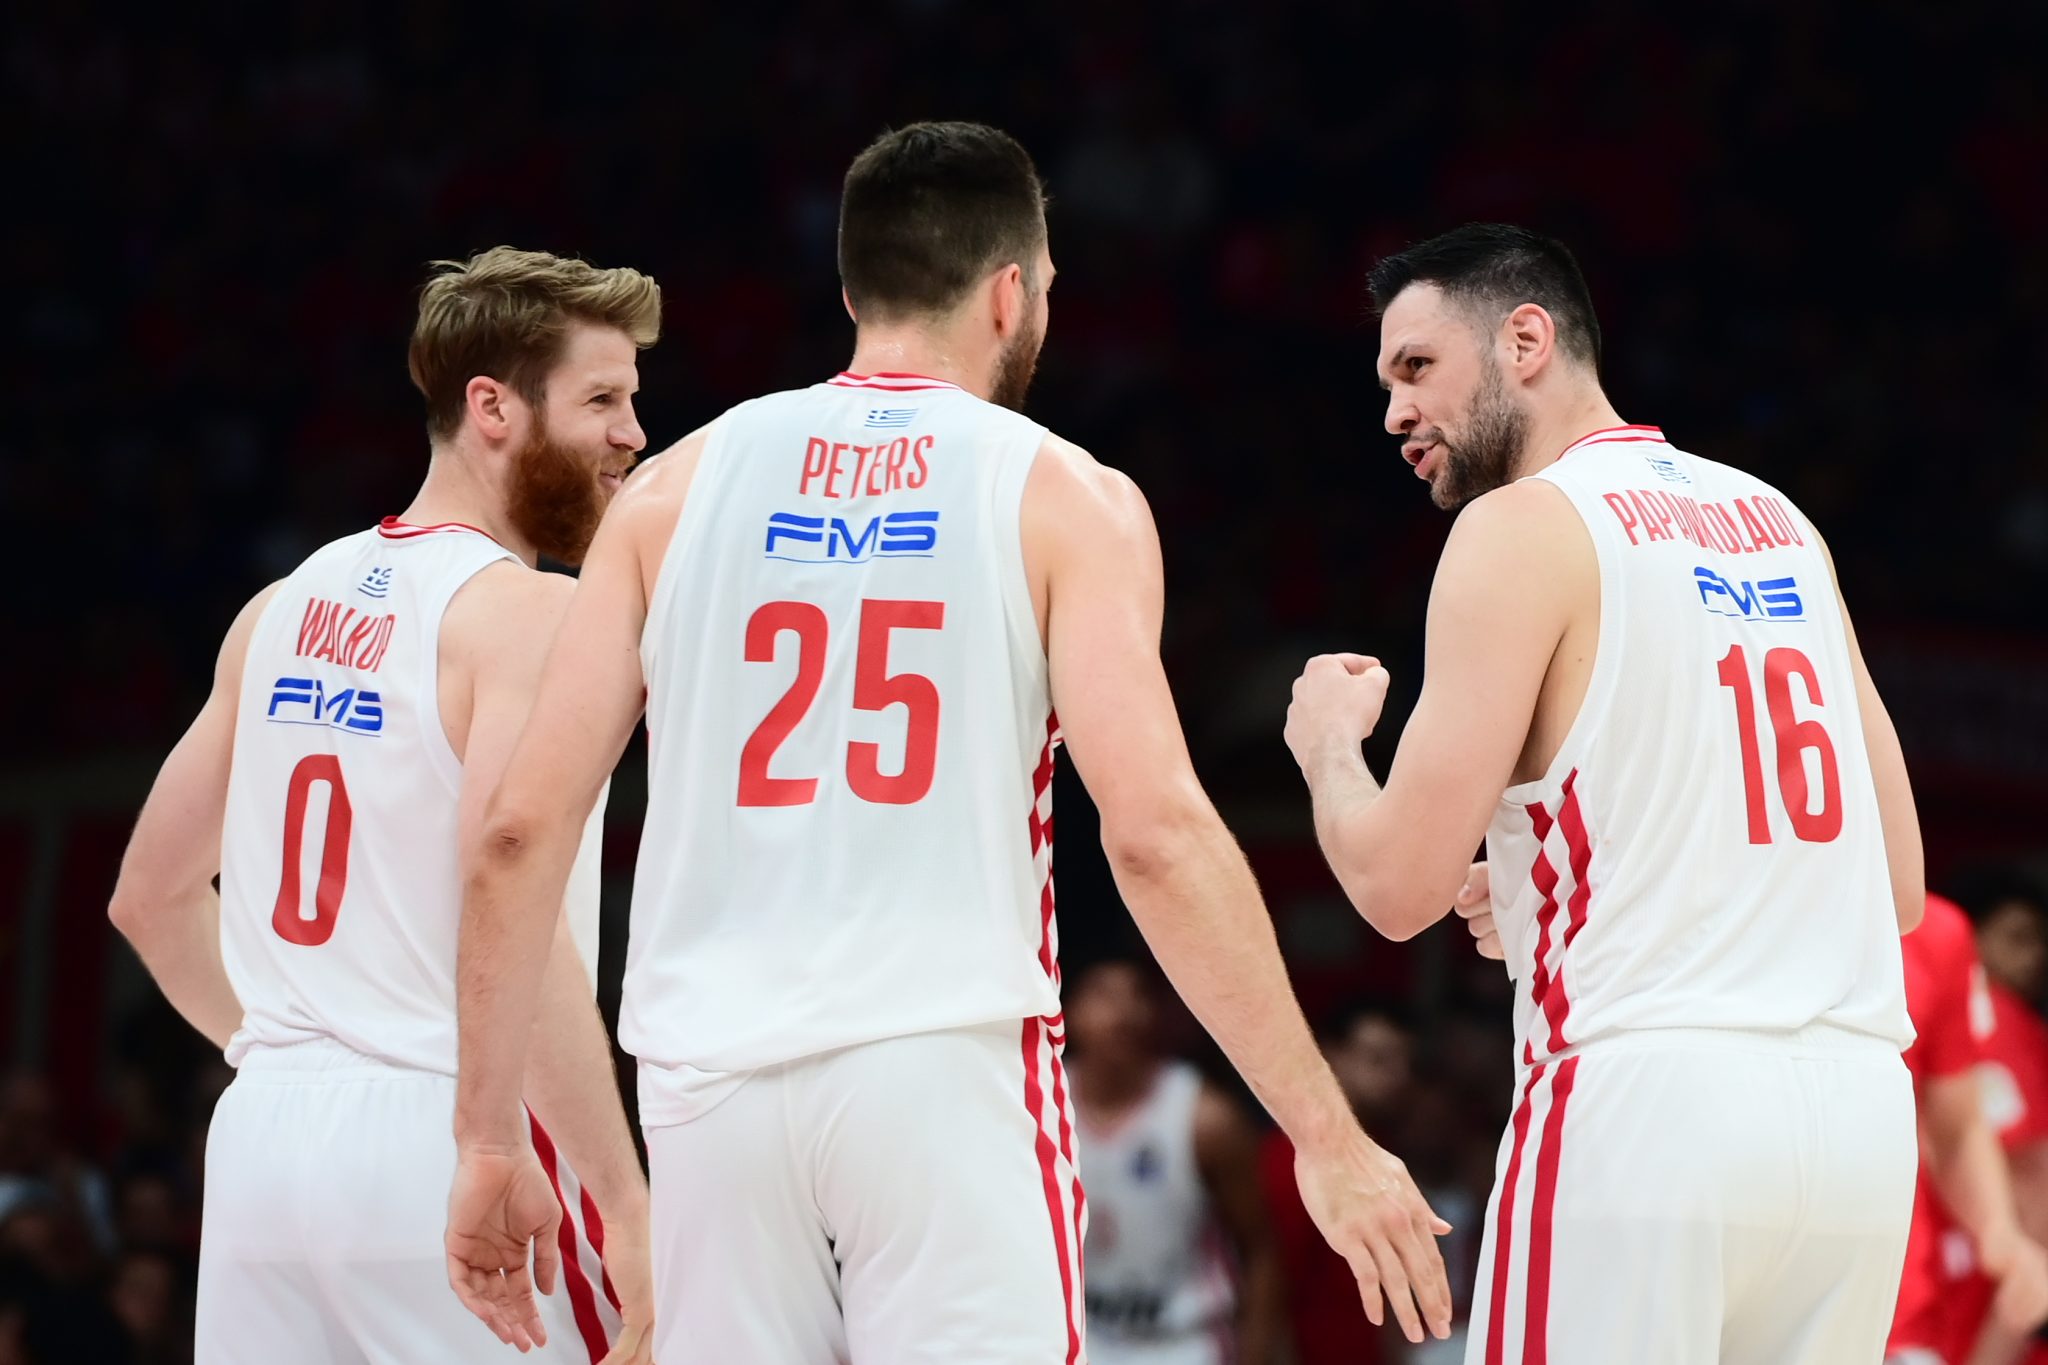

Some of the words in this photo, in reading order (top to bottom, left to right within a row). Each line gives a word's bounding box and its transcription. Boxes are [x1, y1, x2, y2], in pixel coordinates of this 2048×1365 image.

[799, 434, 935, 499] PETERS
[765, 511, 940, 559] FMS
[1693, 566, 1804, 617] FMS
[268, 677, 384, 732] FMS
[736, 598, 945, 808] 25
[1716, 643, 1843, 845] 16
[272, 753, 354, 947] 0
